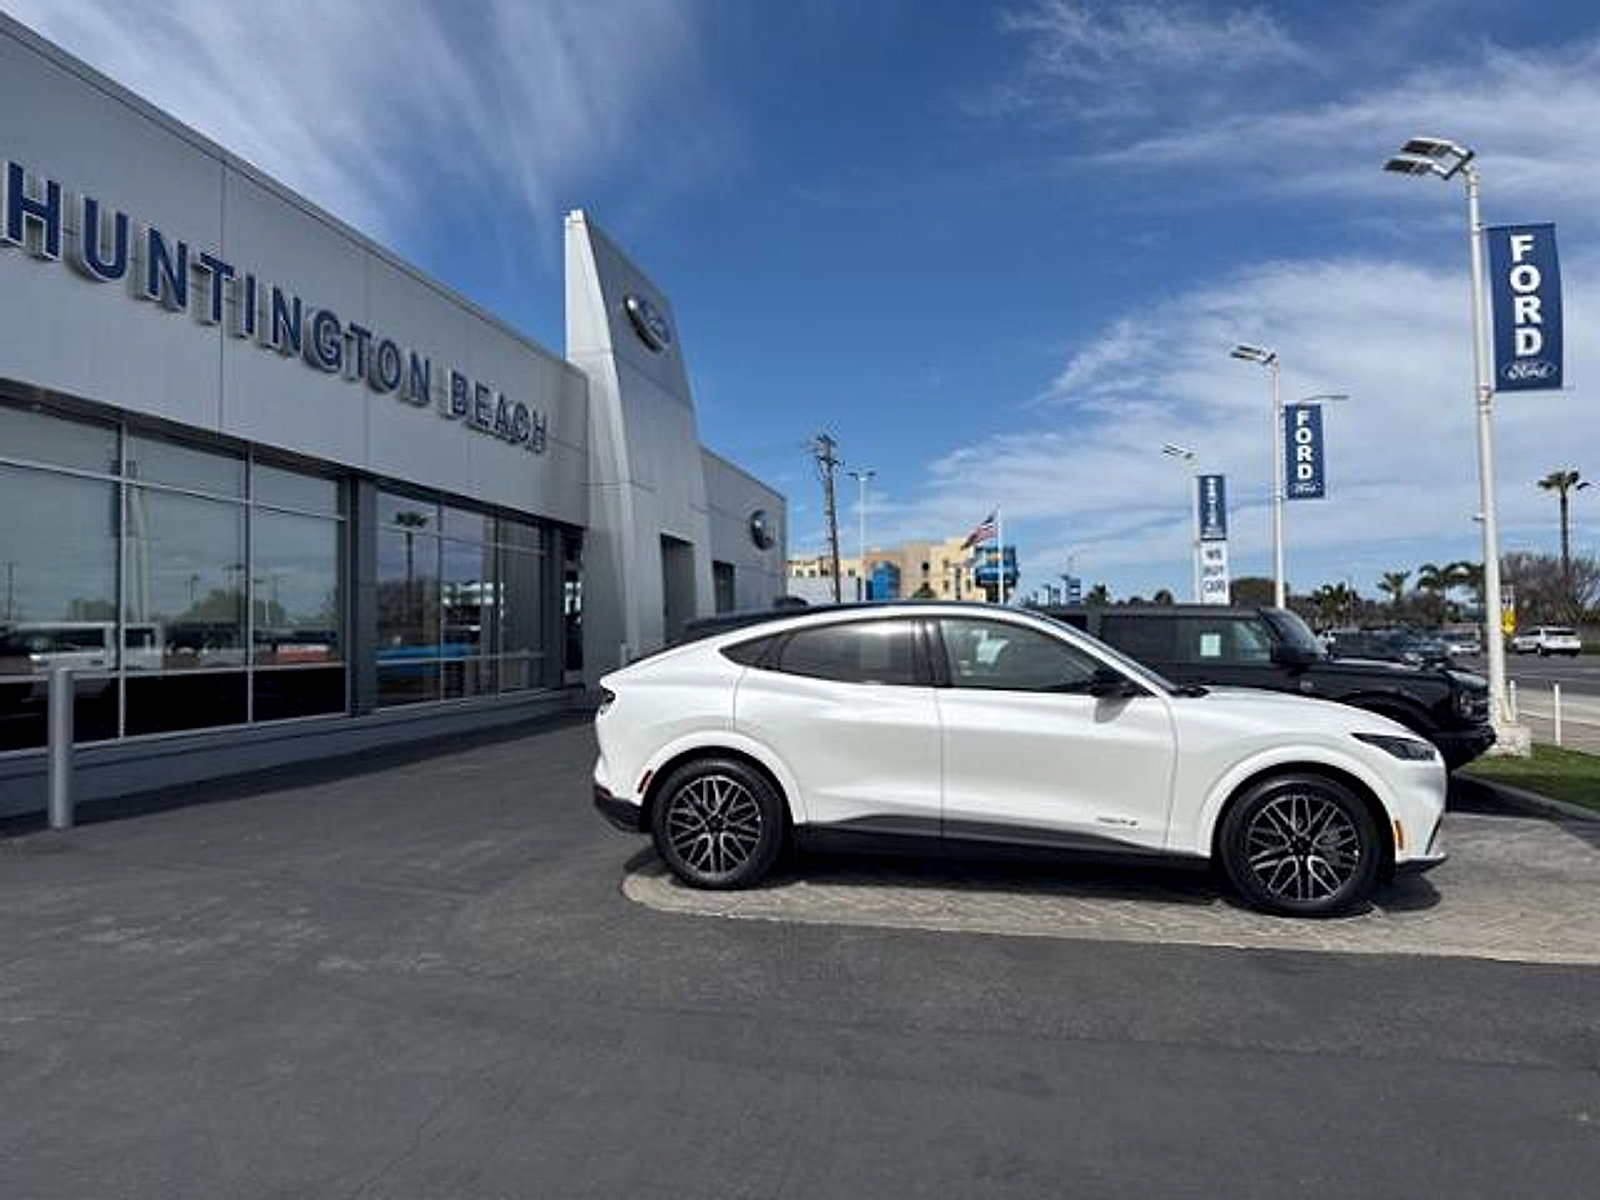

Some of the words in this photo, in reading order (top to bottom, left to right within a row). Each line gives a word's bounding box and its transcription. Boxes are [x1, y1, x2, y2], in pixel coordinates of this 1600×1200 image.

[4, 160, 432, 406] HUNTINGTON
[449, 368, 547, 452] BEACH
[1510, 234, 1542, 356] FORD
[1507, 363, 1550, 380] Ford
[1296, 410, 1312, 479] FORD
